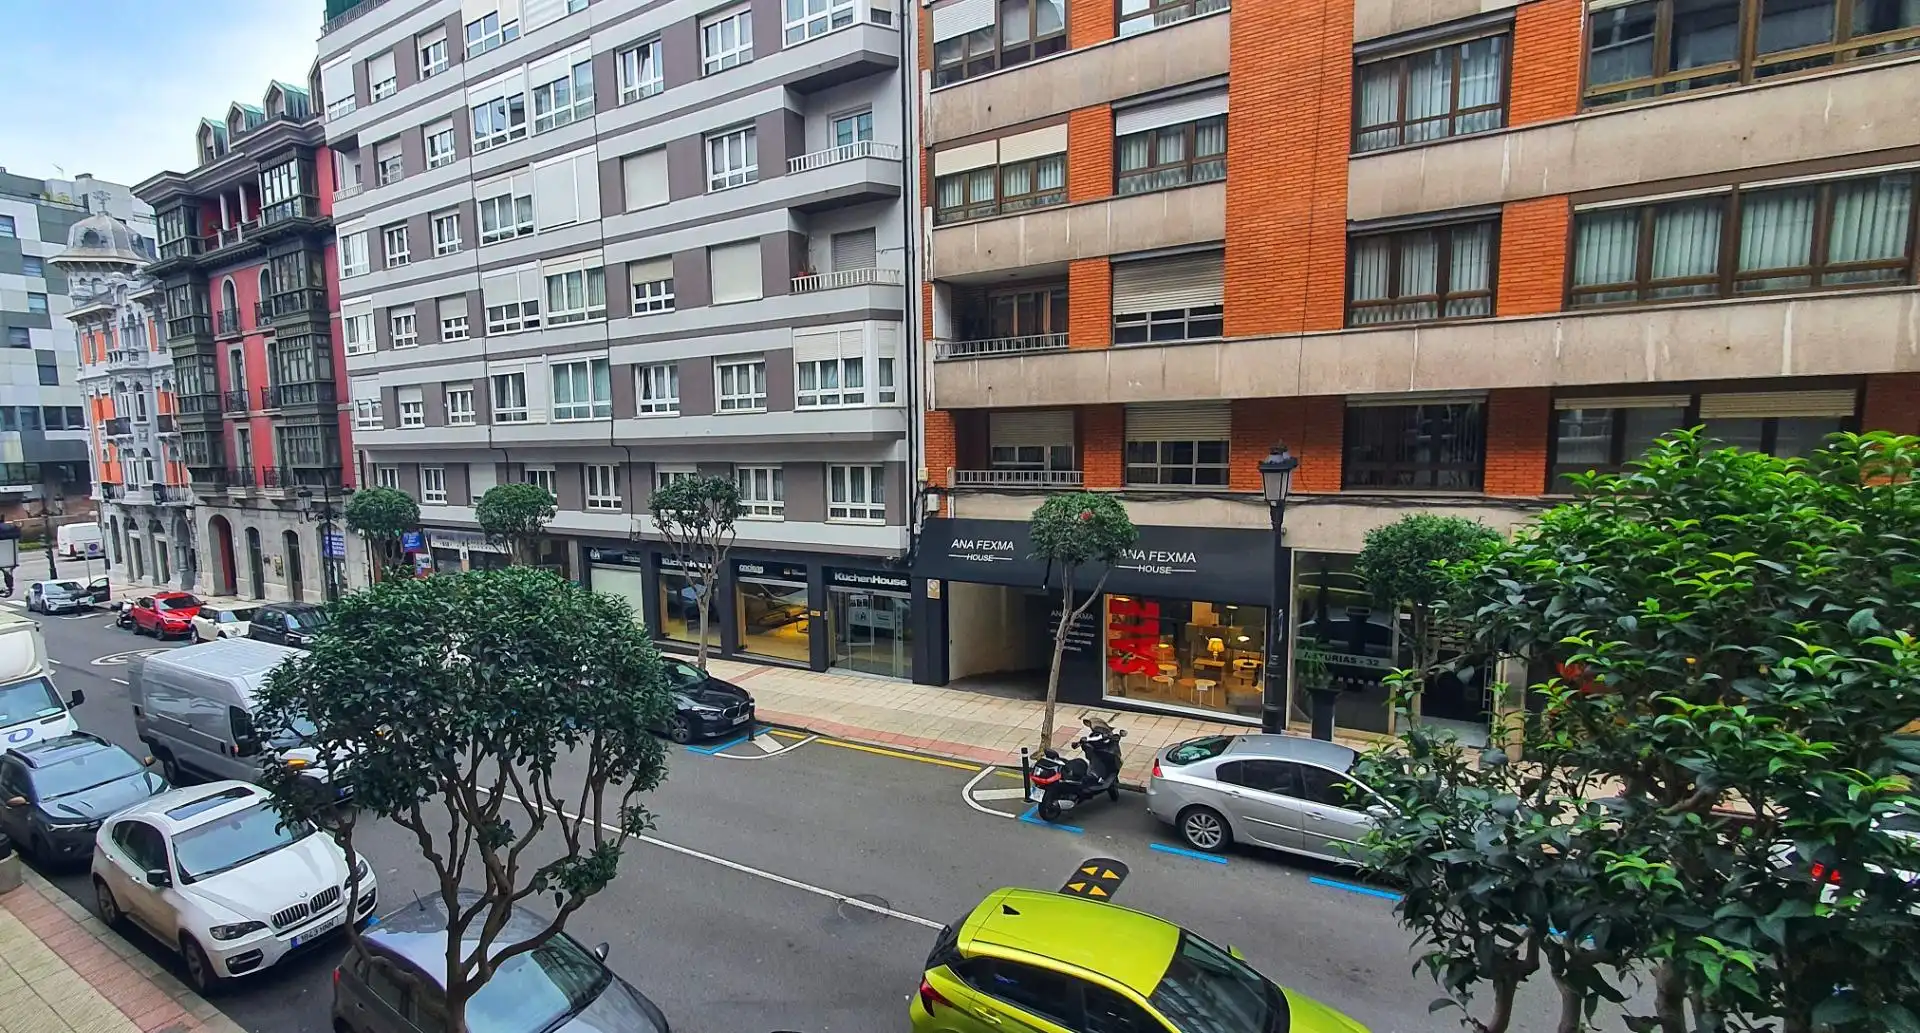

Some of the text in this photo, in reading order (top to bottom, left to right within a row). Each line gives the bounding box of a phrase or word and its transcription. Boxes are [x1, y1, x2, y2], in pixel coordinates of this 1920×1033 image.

[951, 539, 1014, 551] ANA FEXMA
[966, 553, 994, 562] HOUSE
[1119, 548, 1197, 563] ANA FEXMA
[1138, 564, 1172, 574] HOUSE
[1304, 651, 1357, 664] ATURIAS
